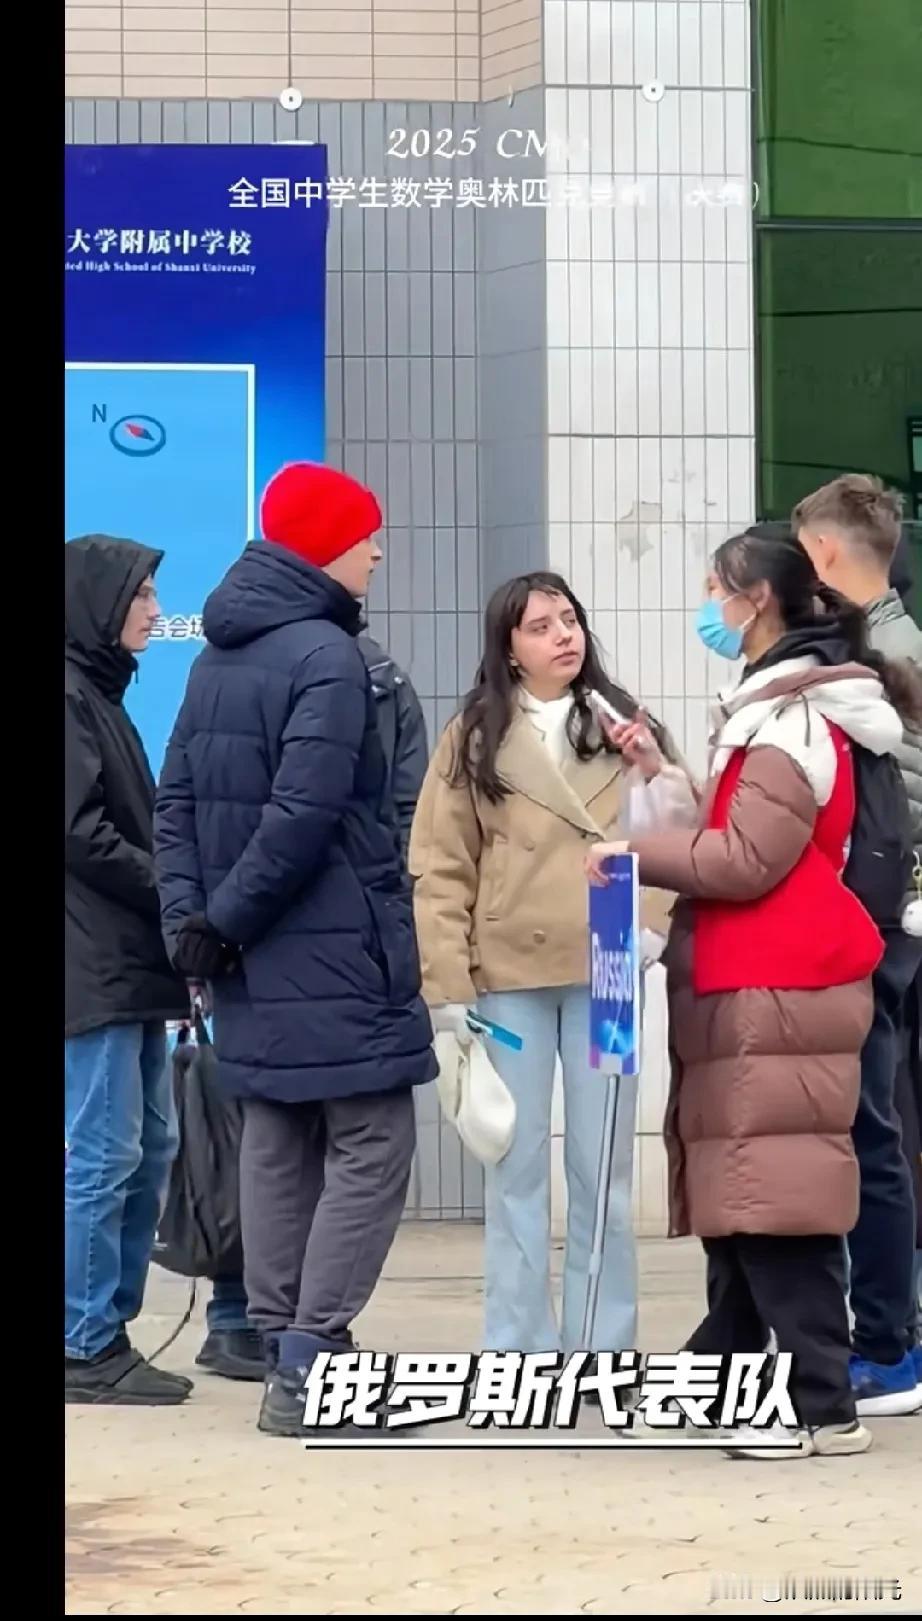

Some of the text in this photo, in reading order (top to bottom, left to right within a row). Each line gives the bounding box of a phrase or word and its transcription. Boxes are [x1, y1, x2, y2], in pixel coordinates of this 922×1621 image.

[66, 228, 253, 256] 大学附属中学校
[85, 260, 111, 273] High
[113, 261, 149, 272] School
[151, 261, 163, 272] of
[202, 262, 256, 276] University
[92, 403, 107, 423] N
[591, 930, 634, 1002] Russia
